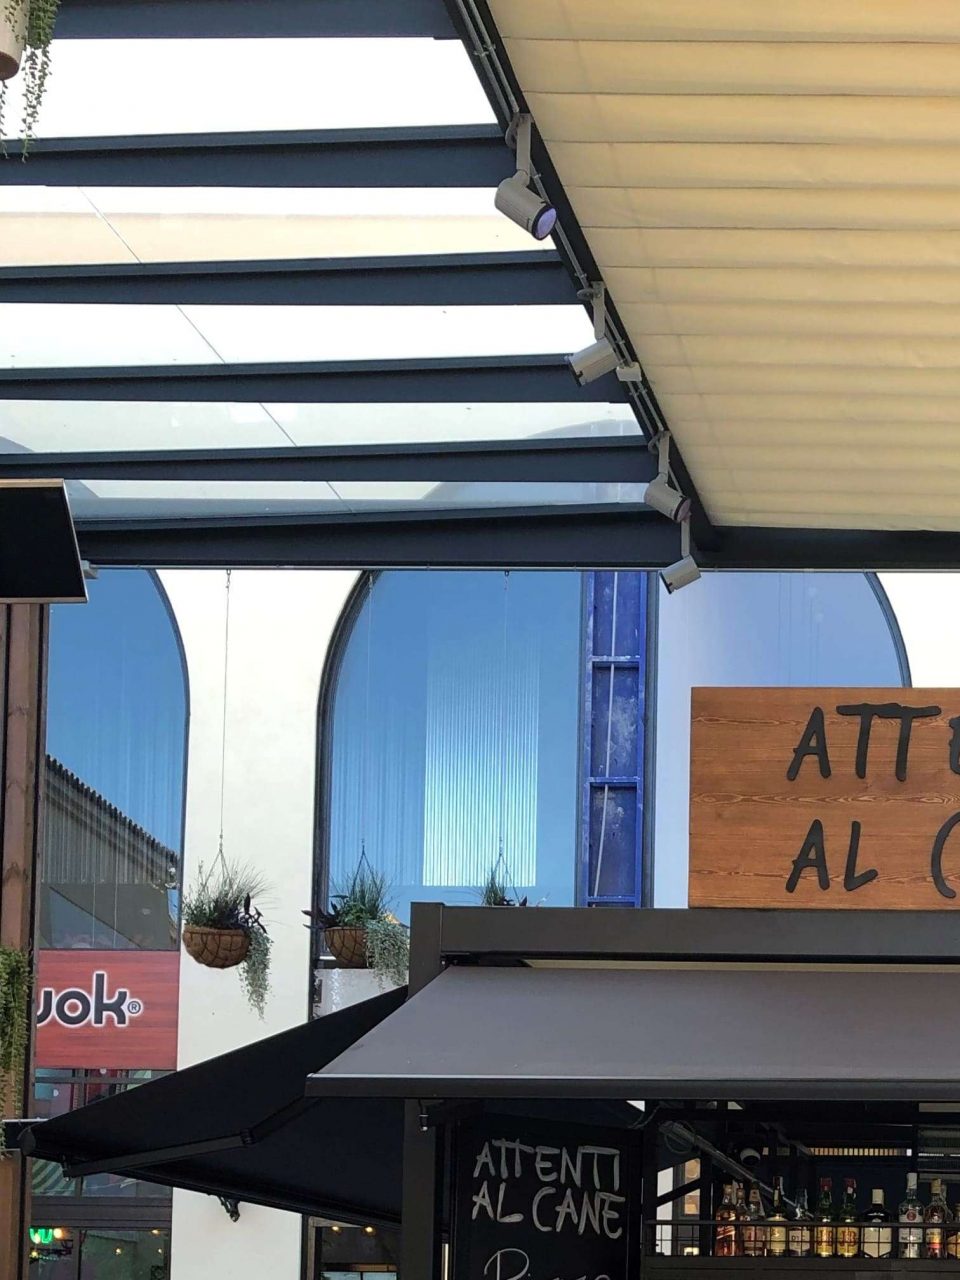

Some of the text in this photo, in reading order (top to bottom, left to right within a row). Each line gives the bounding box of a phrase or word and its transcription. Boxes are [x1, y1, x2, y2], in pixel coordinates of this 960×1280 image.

[785, 818, 879, 893] AL
[473, 1138, 621, 1192] ATTENTI
[472, 1180, 626, 1239] AL CANE
